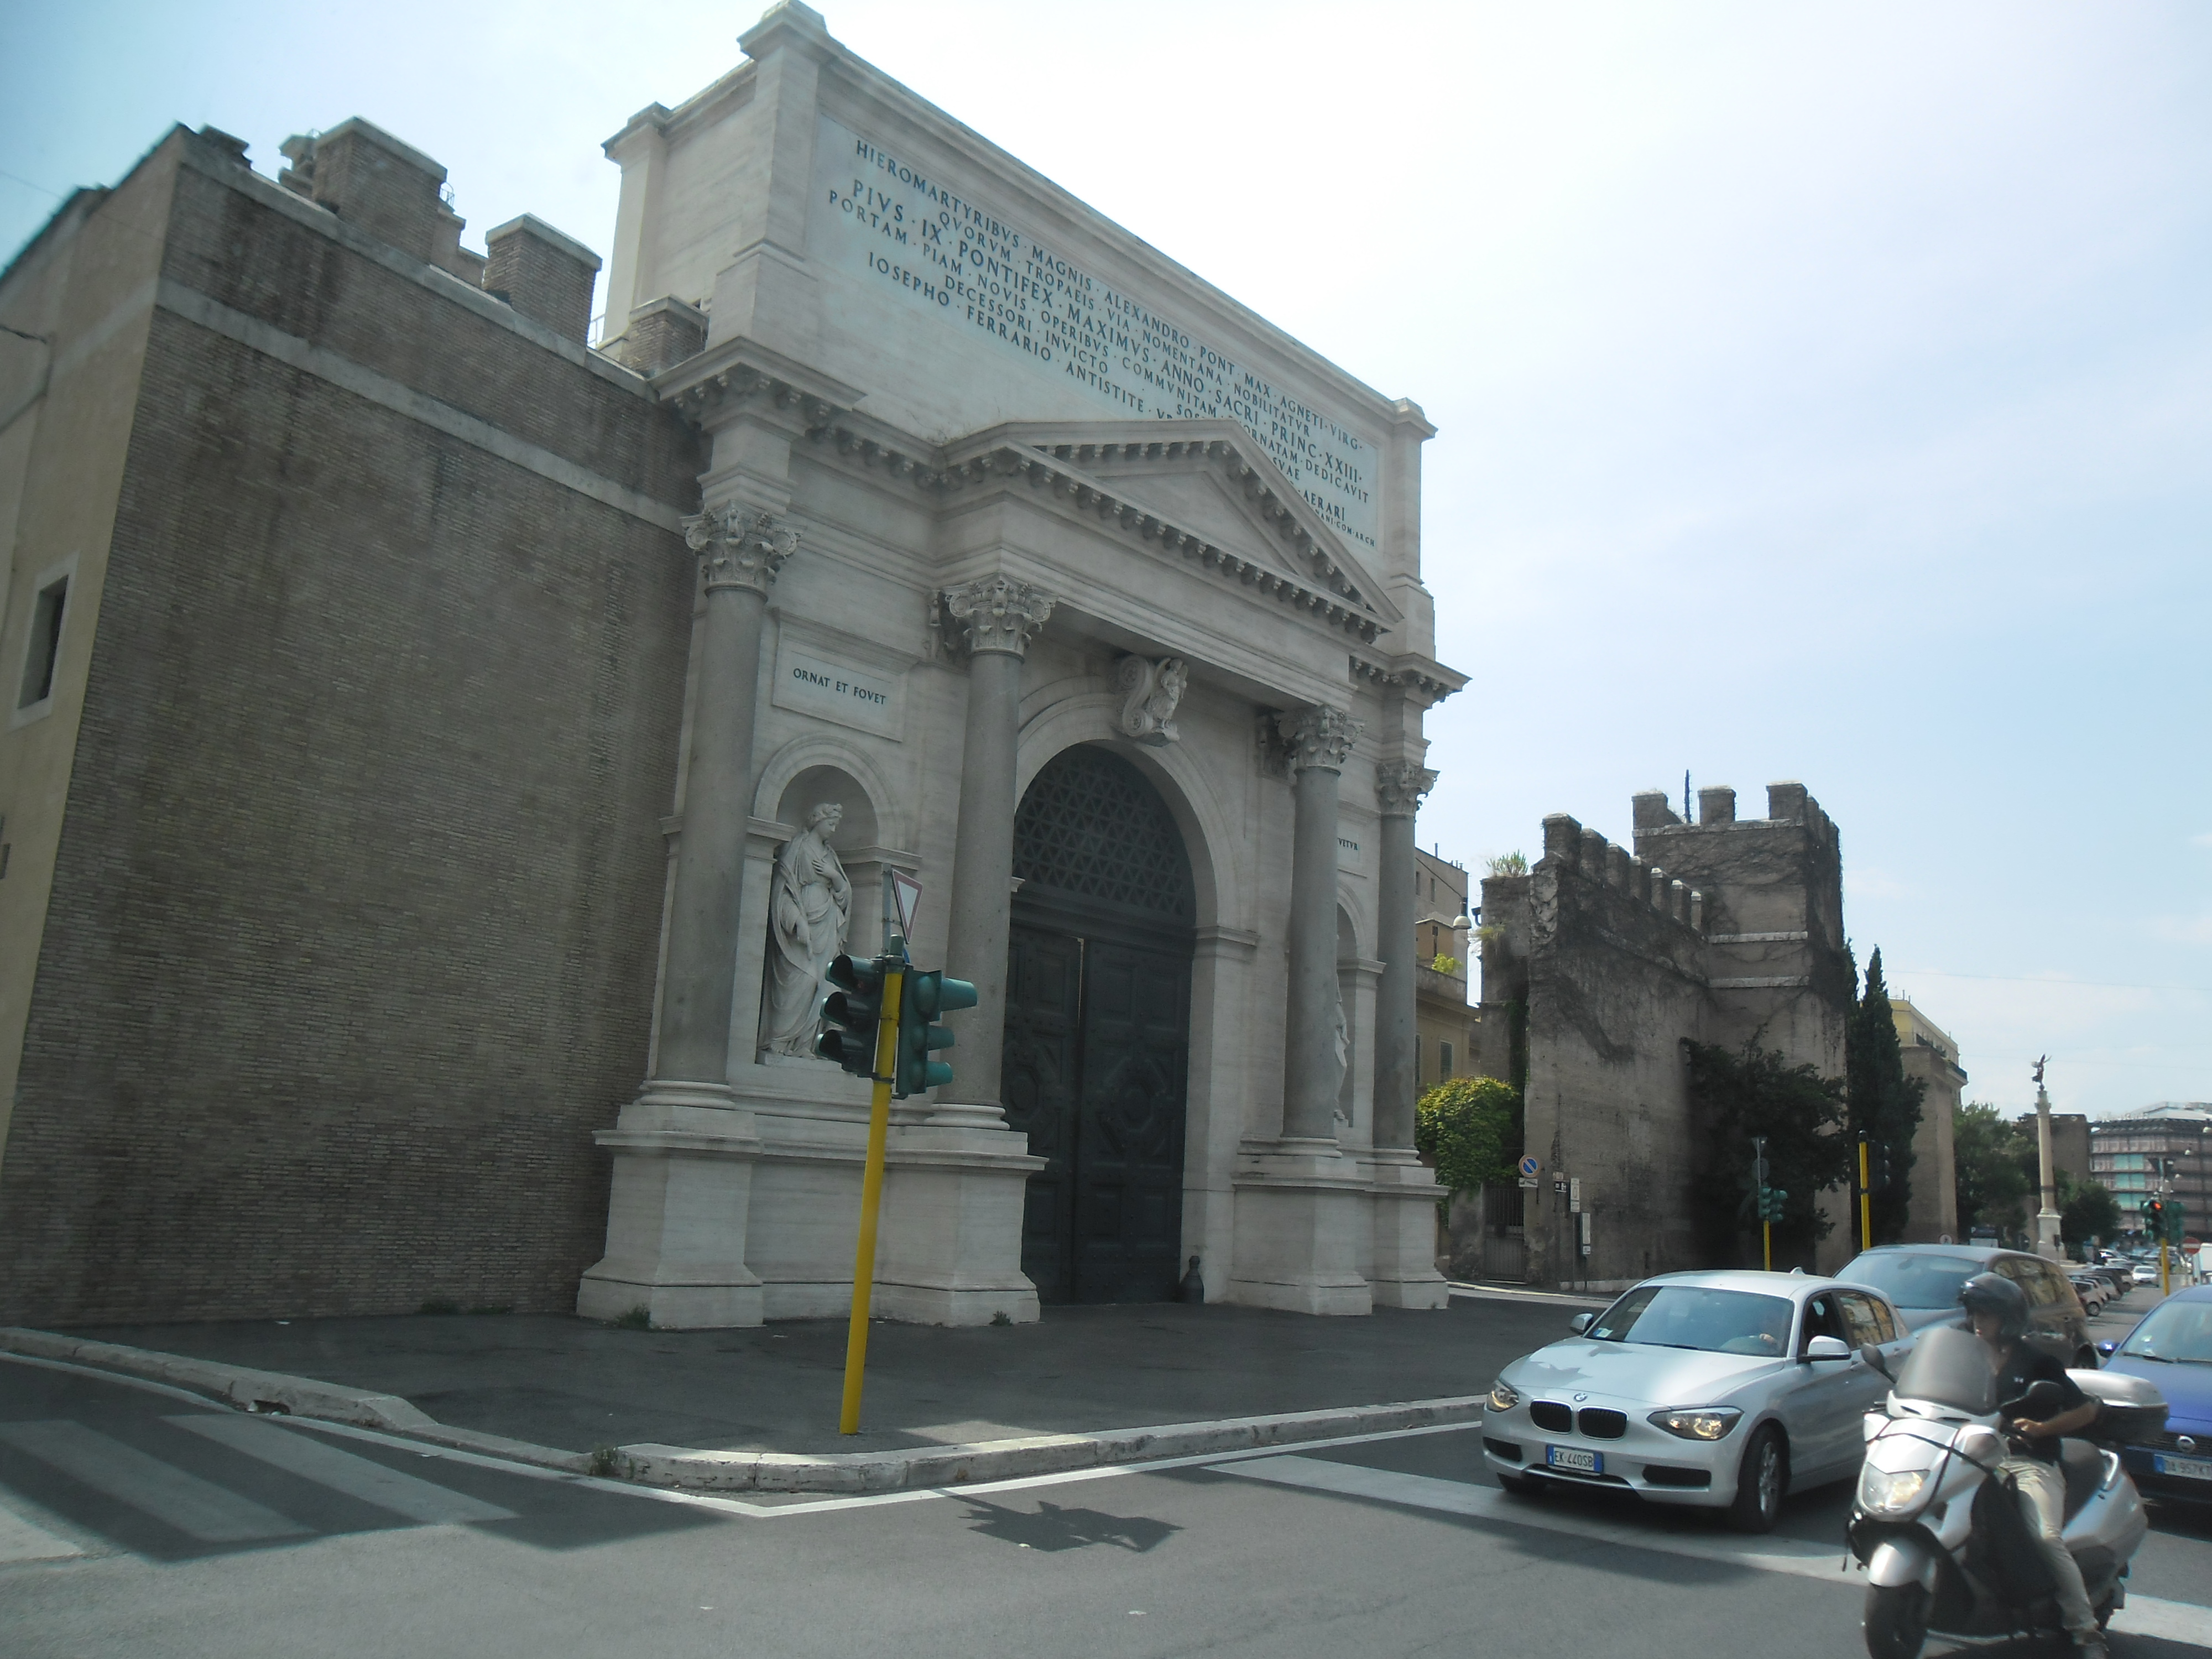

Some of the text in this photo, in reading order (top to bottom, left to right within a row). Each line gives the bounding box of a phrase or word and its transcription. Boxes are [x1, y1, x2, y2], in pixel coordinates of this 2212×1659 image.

[829, 190, 907, 246] PORTAM
[923, 242, 962, 276] PIAM
[978, 274, 1026, 311] NOVIS
[1041, 310, 1109, 358] OPERIBVS
[1122, 357, 1217, 418] COMMVNITAM
[1306, 458, 1369, 503] DEDICAVIT
[853, 179, 904, 222] PIVS
[922, 220, 942, 246] IX
[959, 239, 1053, 308] PONTIFEX
[1068, 303, 1150, 363] MAXIMVS
[1161, 359, 1205, 394] ANNO
[1215, 389, 1258, 425] SACRI
[856, 140, 1019, 248] HIEROMARTYRIBVS
[1032, 245, 1091, 291] MAGNIS
[1105, 290, 1190, 348] ALEXANDRO
[1280, 395, 1323, 430] AGNETI
[868, 252, 950, 306] IOSEPHO
[967, 305, 1051, 362] FERRARIO
[1066, 360, 1144, 413] ANTISTITE
[1303, 489, 1345, 521] AERARI
[940, 211, 1310, 437] QVORVM TROPAEIS VIA NOMENTANA NOBILITATVR
[945, 275, 1032, 333] DECESSORI
[1046, 332, 1108, 374] INVICTO
[793, 668, 886, 705] ORNAT ET FOVET
[1554, 1451, 1564, 1463] EK
